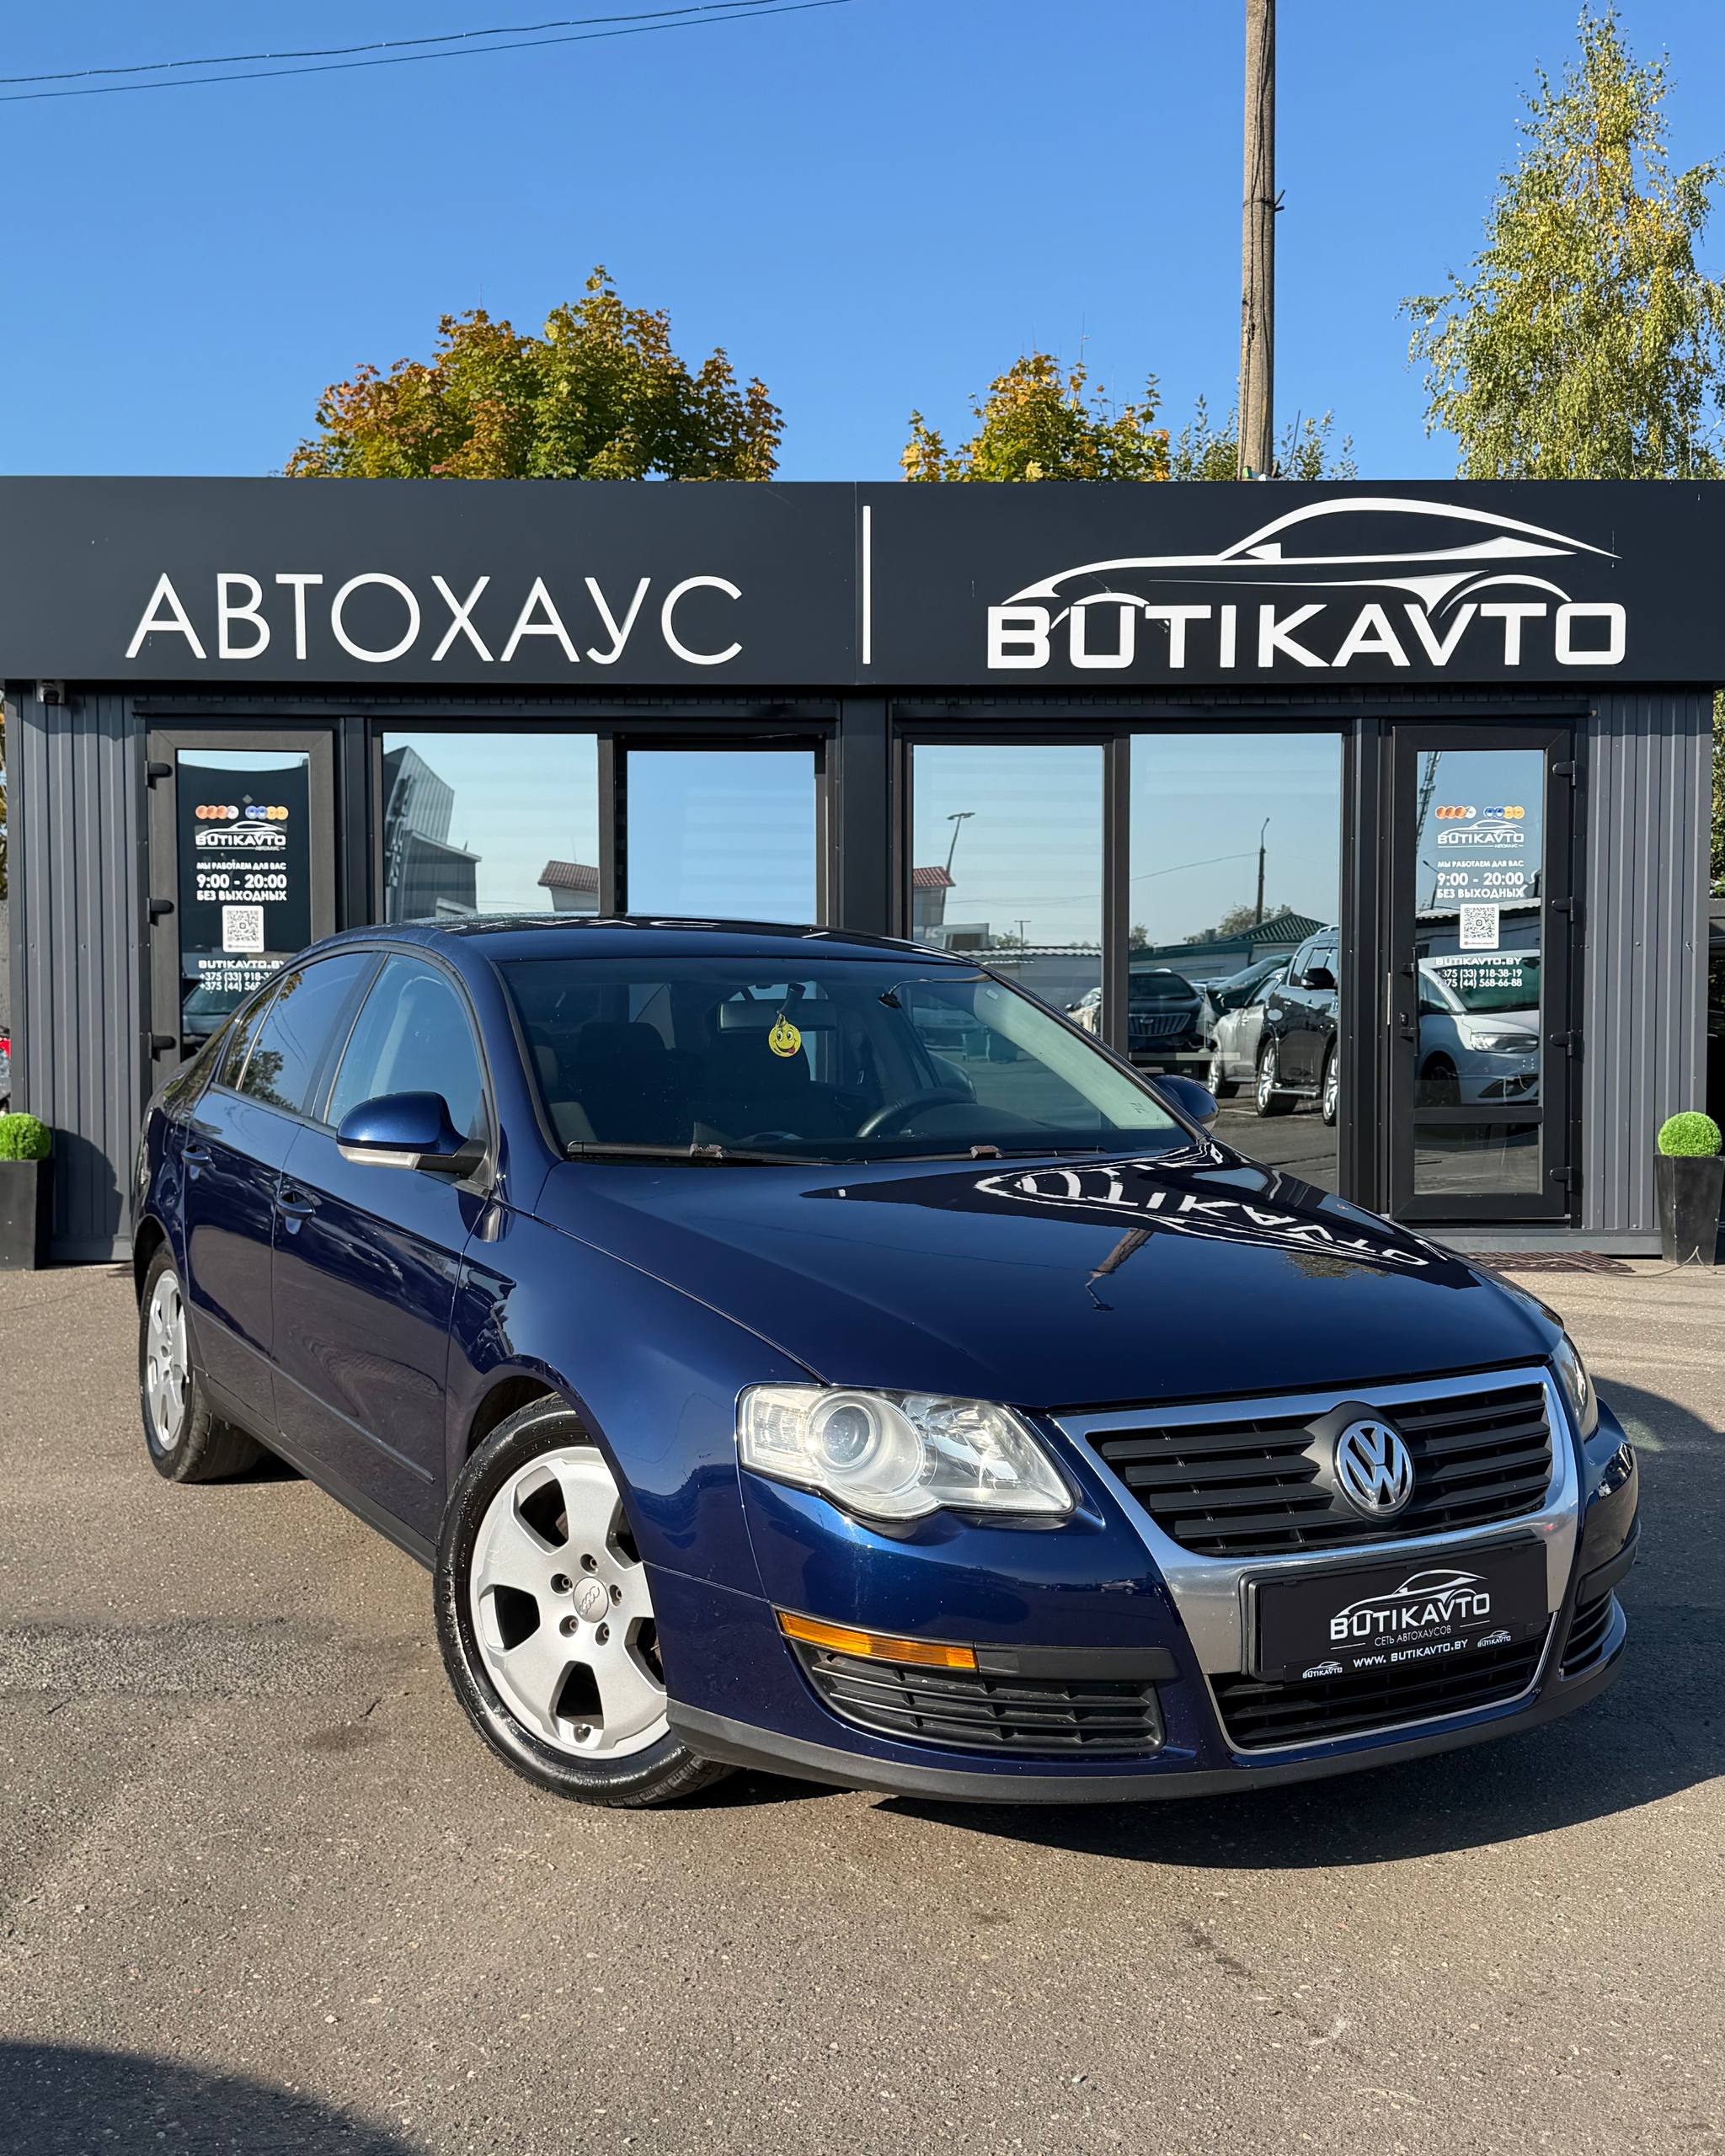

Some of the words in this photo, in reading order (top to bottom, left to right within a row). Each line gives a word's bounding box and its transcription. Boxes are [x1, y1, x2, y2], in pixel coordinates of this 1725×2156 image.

[126, 573, 743, 665] АВТОХАУС
[987, 602, 1626, 669] BUTIKAVTO
[195, 835, 286, 846] BUTIKAVTO
[1437, 833, 1525, 844] BUTIKAVTO
[252, 862, 269, 871] ДЛЯ
[196, 874, 230, 889] 9:00
[244, 874, 287, 889] 20:00
[1437, 873, 1468, 886] 9:00
[1483, 873, 1525, 886] 20:00
[196, 890, 216, 901] БЕЗ
[218, 890, 287, 902] ВЫХОДНЫХ
[1437, 889, 1455, 899] БЕЗ
[1458, 889, 1525, 899] ВЫХОДНЫХ
[1435, 957, 1523, 966] BUTIKAVTO.BY
[199, 972, 222, 981] +375
[224, 972, 242, 982] (33)
[1460, 969, 1477, 979] (33)
[1479, 969, 1523, 978] 918-38-19
[199, 981, 222, 991] +375
[224, 982, 242, 992] (44)
[1460, 979, 1477, 989] (44)
[1479, 978, 1523, 987] 568-66-88
[1330, 1593, 1491, 1641] BUTIKAVTO
[1374, 1636, 1395, 1646] СЕТЬ
[1396, 1625, 1452, 1643] АВТОХАУСОВ
[1353, 1654, 1386, 1668] WWW.
[1391, 1639, 1468, 1662] BUTIKAVTO.BY
[1302, 1666, 1343, 1679] BUTIKAVTO
